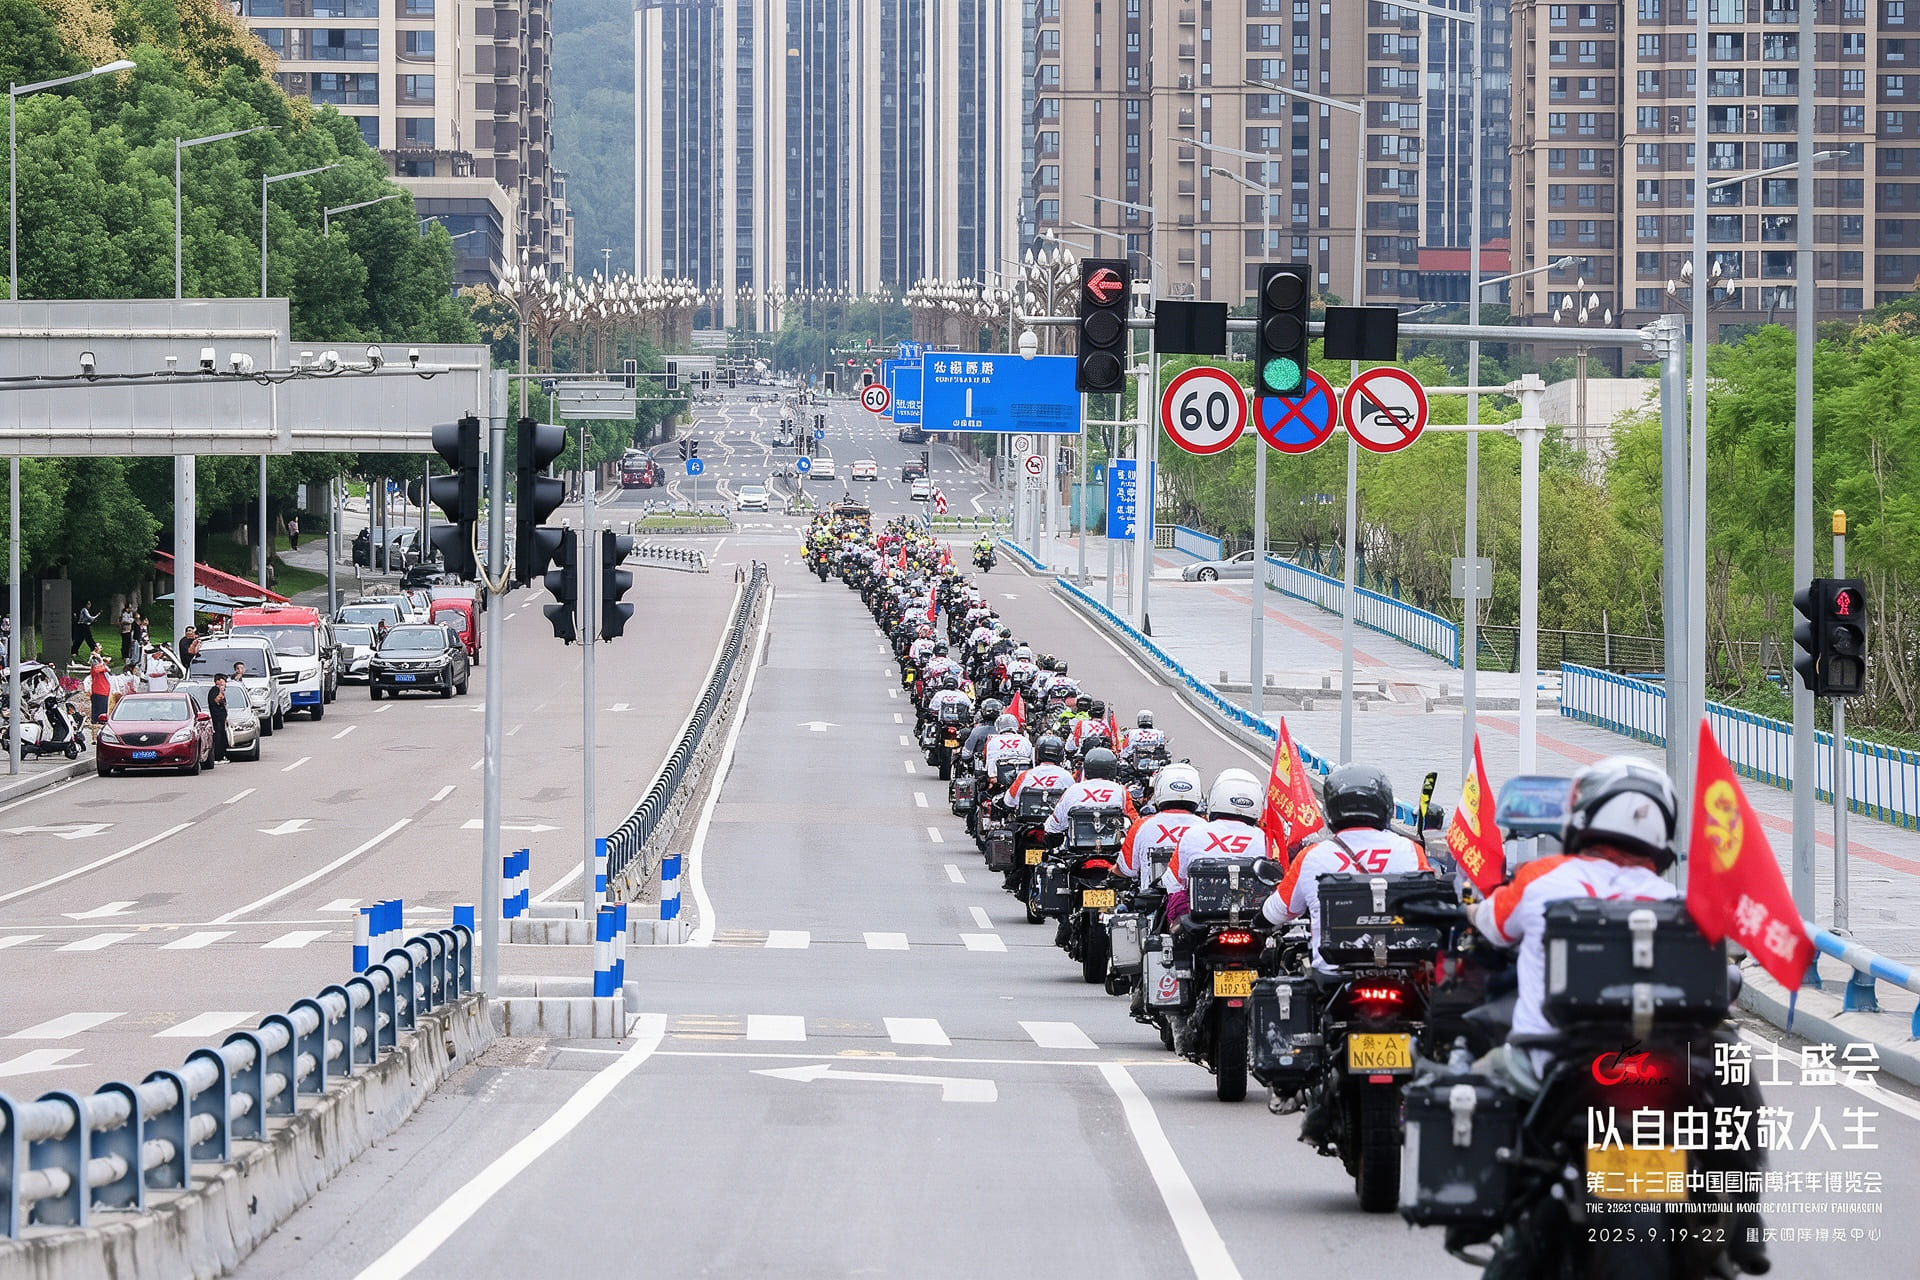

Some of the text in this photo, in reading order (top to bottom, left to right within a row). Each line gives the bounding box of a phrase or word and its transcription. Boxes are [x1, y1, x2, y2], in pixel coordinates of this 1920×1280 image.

[866, 391, 885, 405] 60
[1180, 391, 1230, 431] 60
[1081, 788, 1114, 803] X5
[1204, 831, 1253, 853] X5
[1334, 848, 1392, 874] X5
